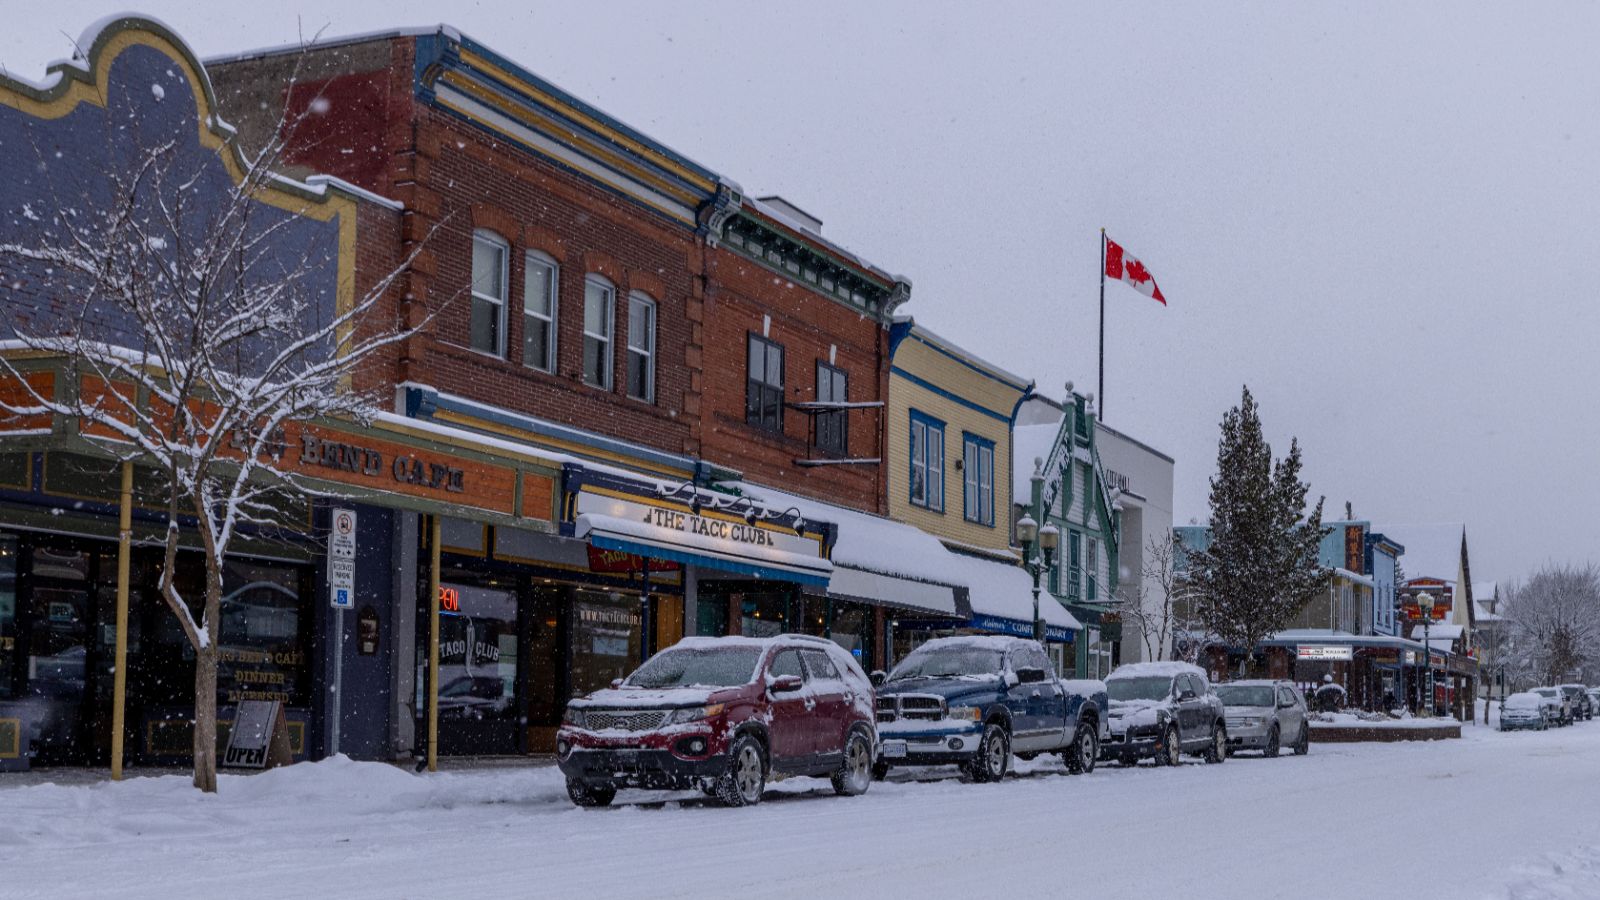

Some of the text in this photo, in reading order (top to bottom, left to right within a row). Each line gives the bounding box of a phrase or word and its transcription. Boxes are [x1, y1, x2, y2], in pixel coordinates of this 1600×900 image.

[301, 434, 382, 476] BEND
[393, 456, 465, 492] CAFE
[655, 508, 685, 531] THE
[731, 525, 768, 545] CLUB
[439, 587, 459, 611] PEN
[440, 640, 499, 660] TACO CLUB
[235, 670, 285, 684] DINNER
[226, 744, 266, 764] OPEN
